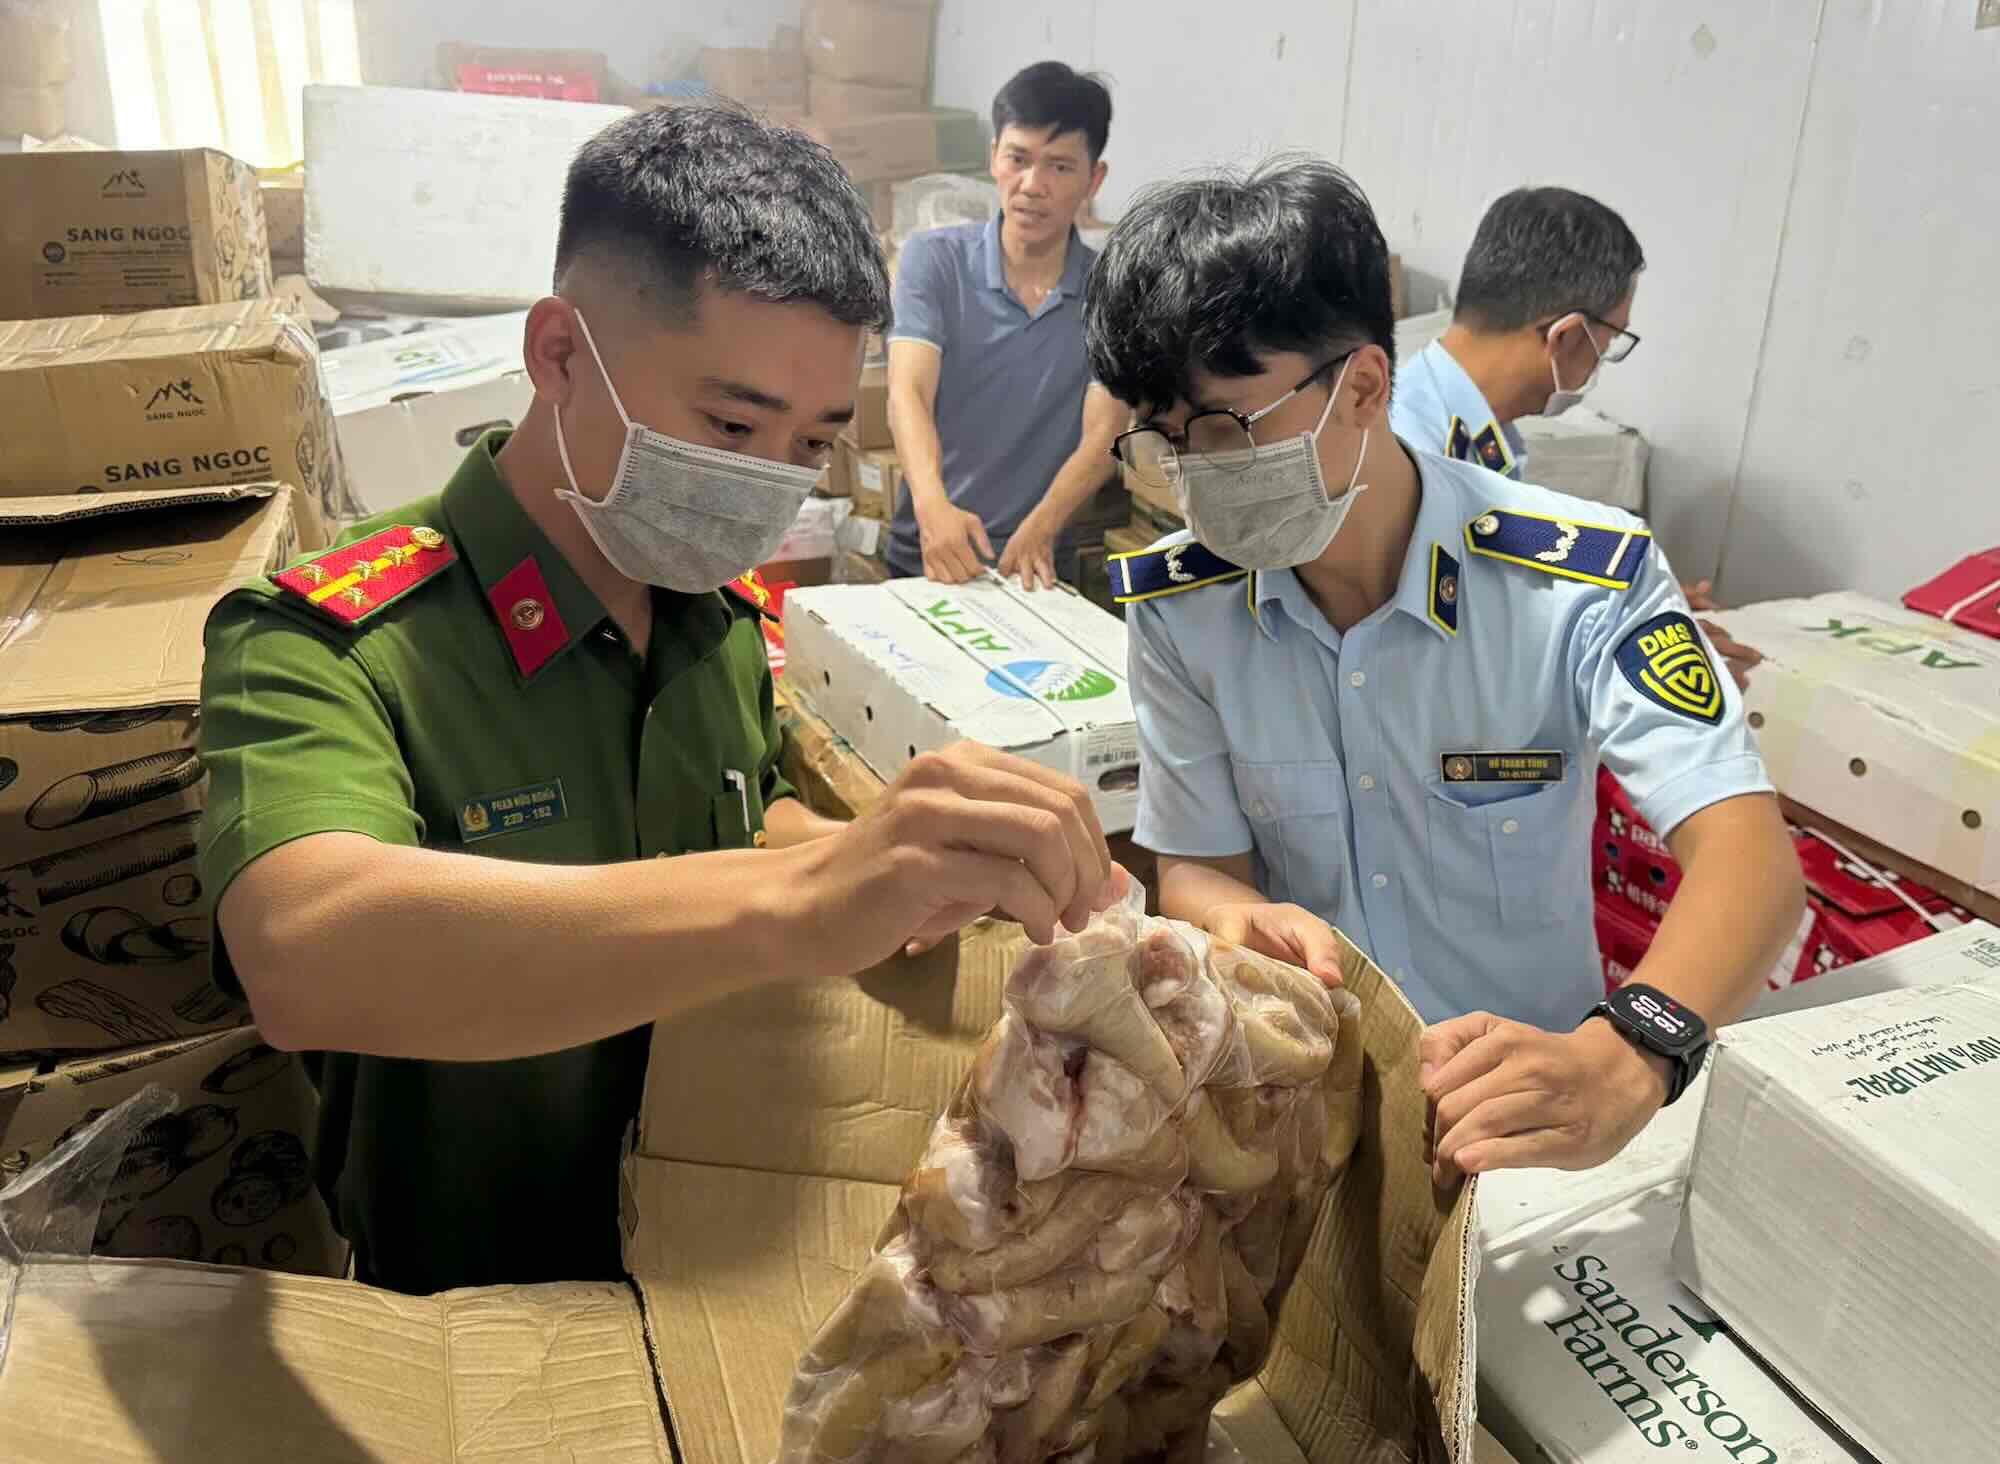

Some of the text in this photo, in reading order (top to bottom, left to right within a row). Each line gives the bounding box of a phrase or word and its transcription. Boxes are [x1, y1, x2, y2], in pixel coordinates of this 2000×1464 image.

[67, 226, 191, 242] SANG NGOC
[104, 458, 182, 483] SANG
[191, 445, 271, 473] NGOC
[1638, 622, 1692, 657] DMS
[1630, 994, 1663, 1019] 09
[1653, 1010, 1685, 1035] 16
[1552, 1255, 1779, 1464] Sanderson
